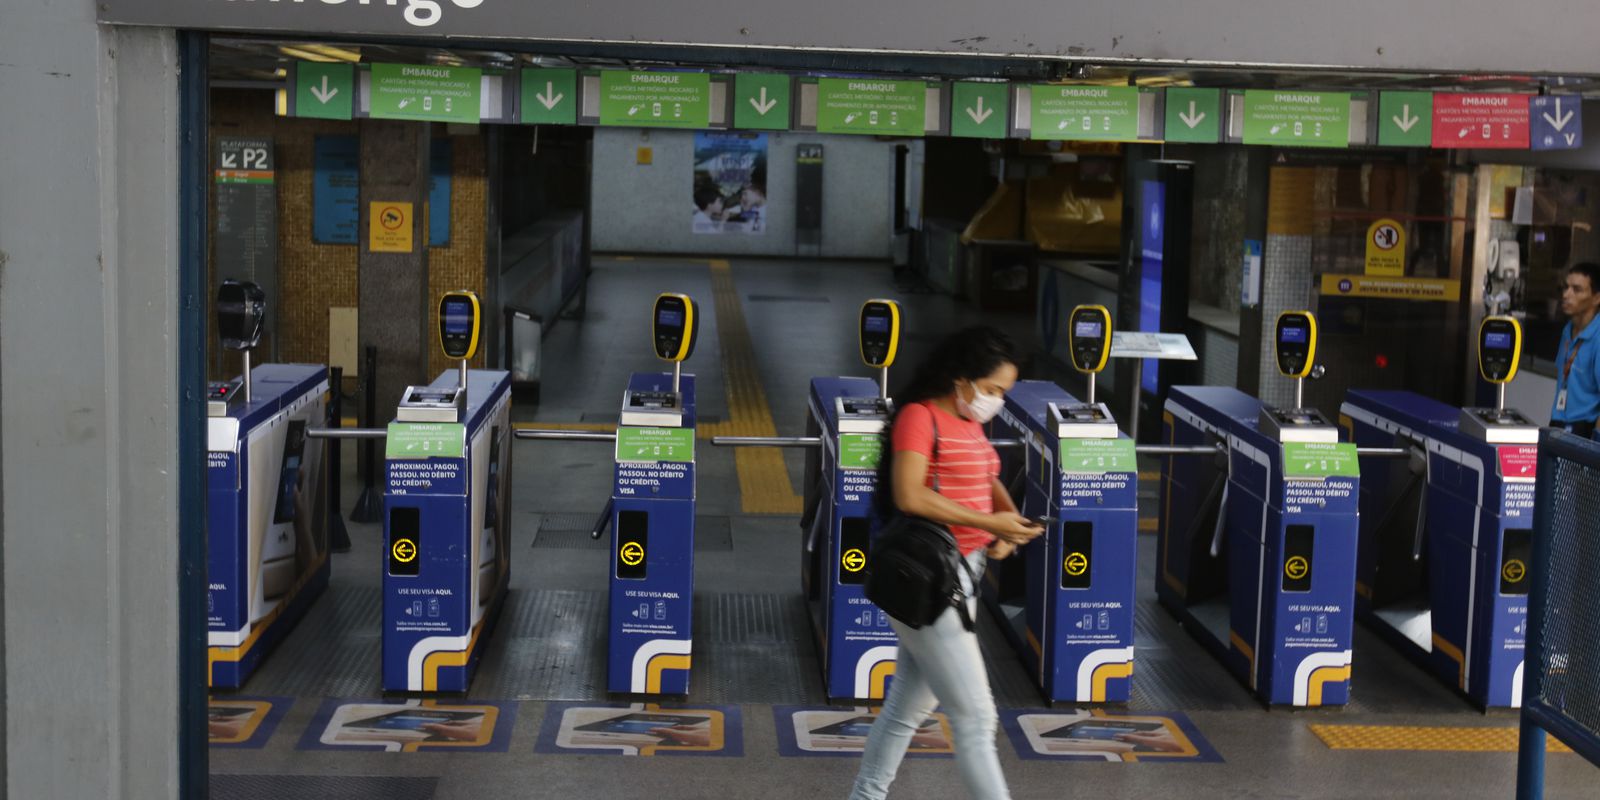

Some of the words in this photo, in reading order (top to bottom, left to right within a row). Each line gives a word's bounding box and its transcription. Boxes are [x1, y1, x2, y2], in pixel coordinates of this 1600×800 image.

[402, 68, 450, 77] EMBARQUE
[631, 75, 680, 84] EMBARQUE
[848, 83, 896, 92] EMBARQUE
[1061, 89, 1108, 97] EMBARQUE
[1274, 95, 1320, 103] EMBARQUE
[1462, 97, 1508, 106] EMBARQUE
[1565, 133, 1575, 146] V
[243, 148, 268, 169] P2
